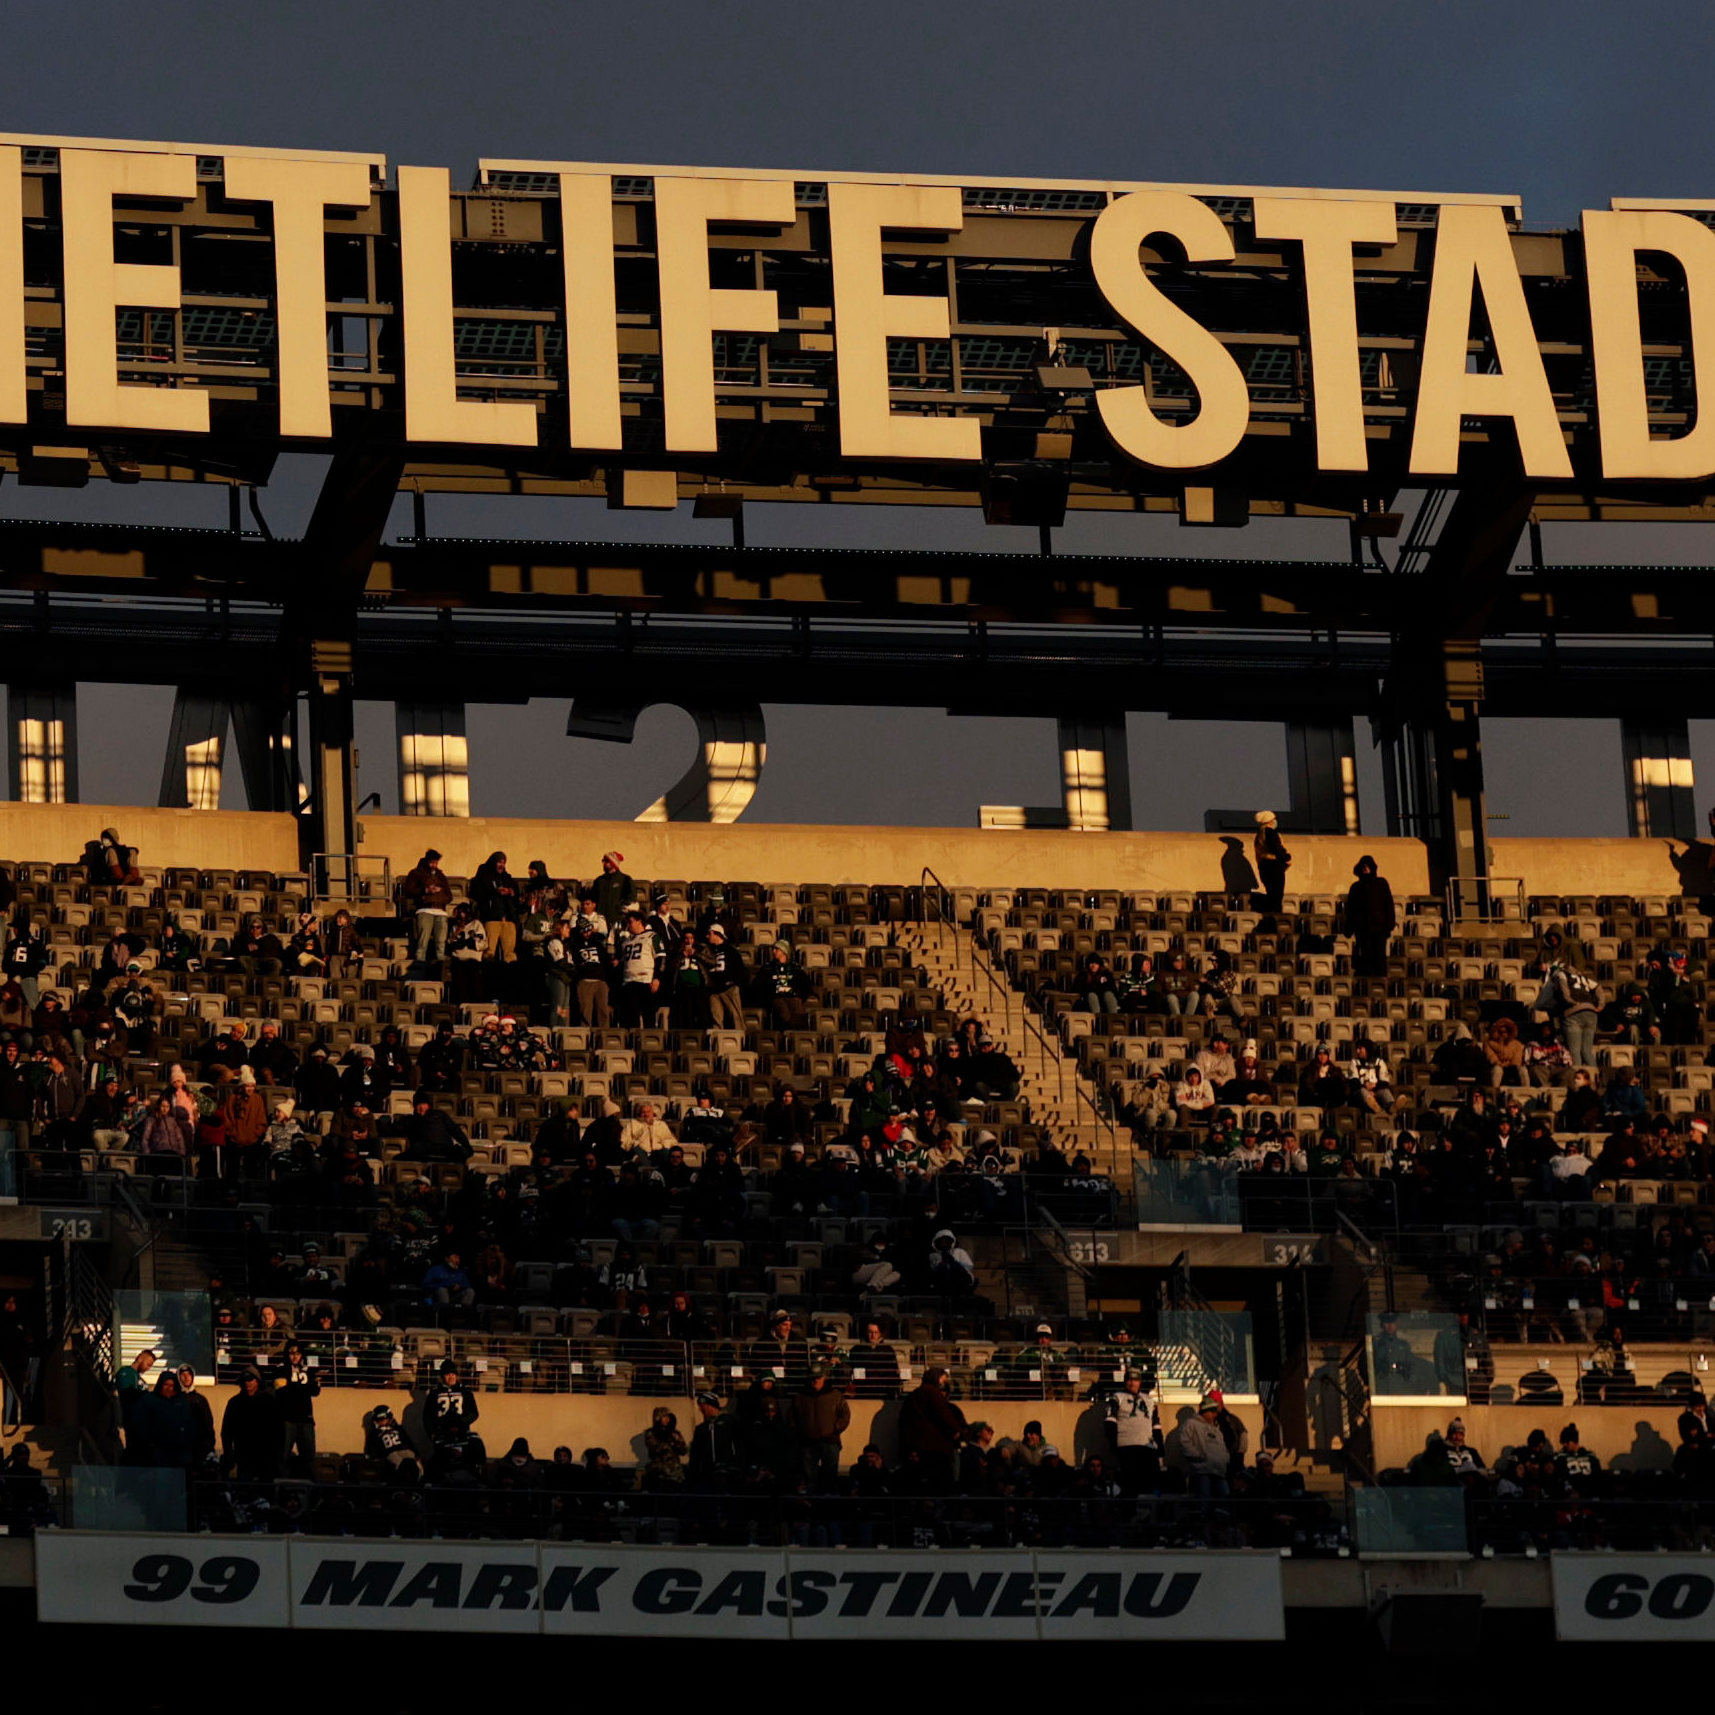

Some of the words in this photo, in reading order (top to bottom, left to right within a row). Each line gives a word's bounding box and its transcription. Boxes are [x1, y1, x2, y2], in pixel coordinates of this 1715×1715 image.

[14, 946, 28, 963] 6
[625, 943, 643, 961] 92
[123, 1554, 260, 1604] 99
[300, 1559, 620, 1612] MARK
[631, 1567, 1202, 1619] GASTINEAU
[1584, 1573, 1715, 1620] 60
